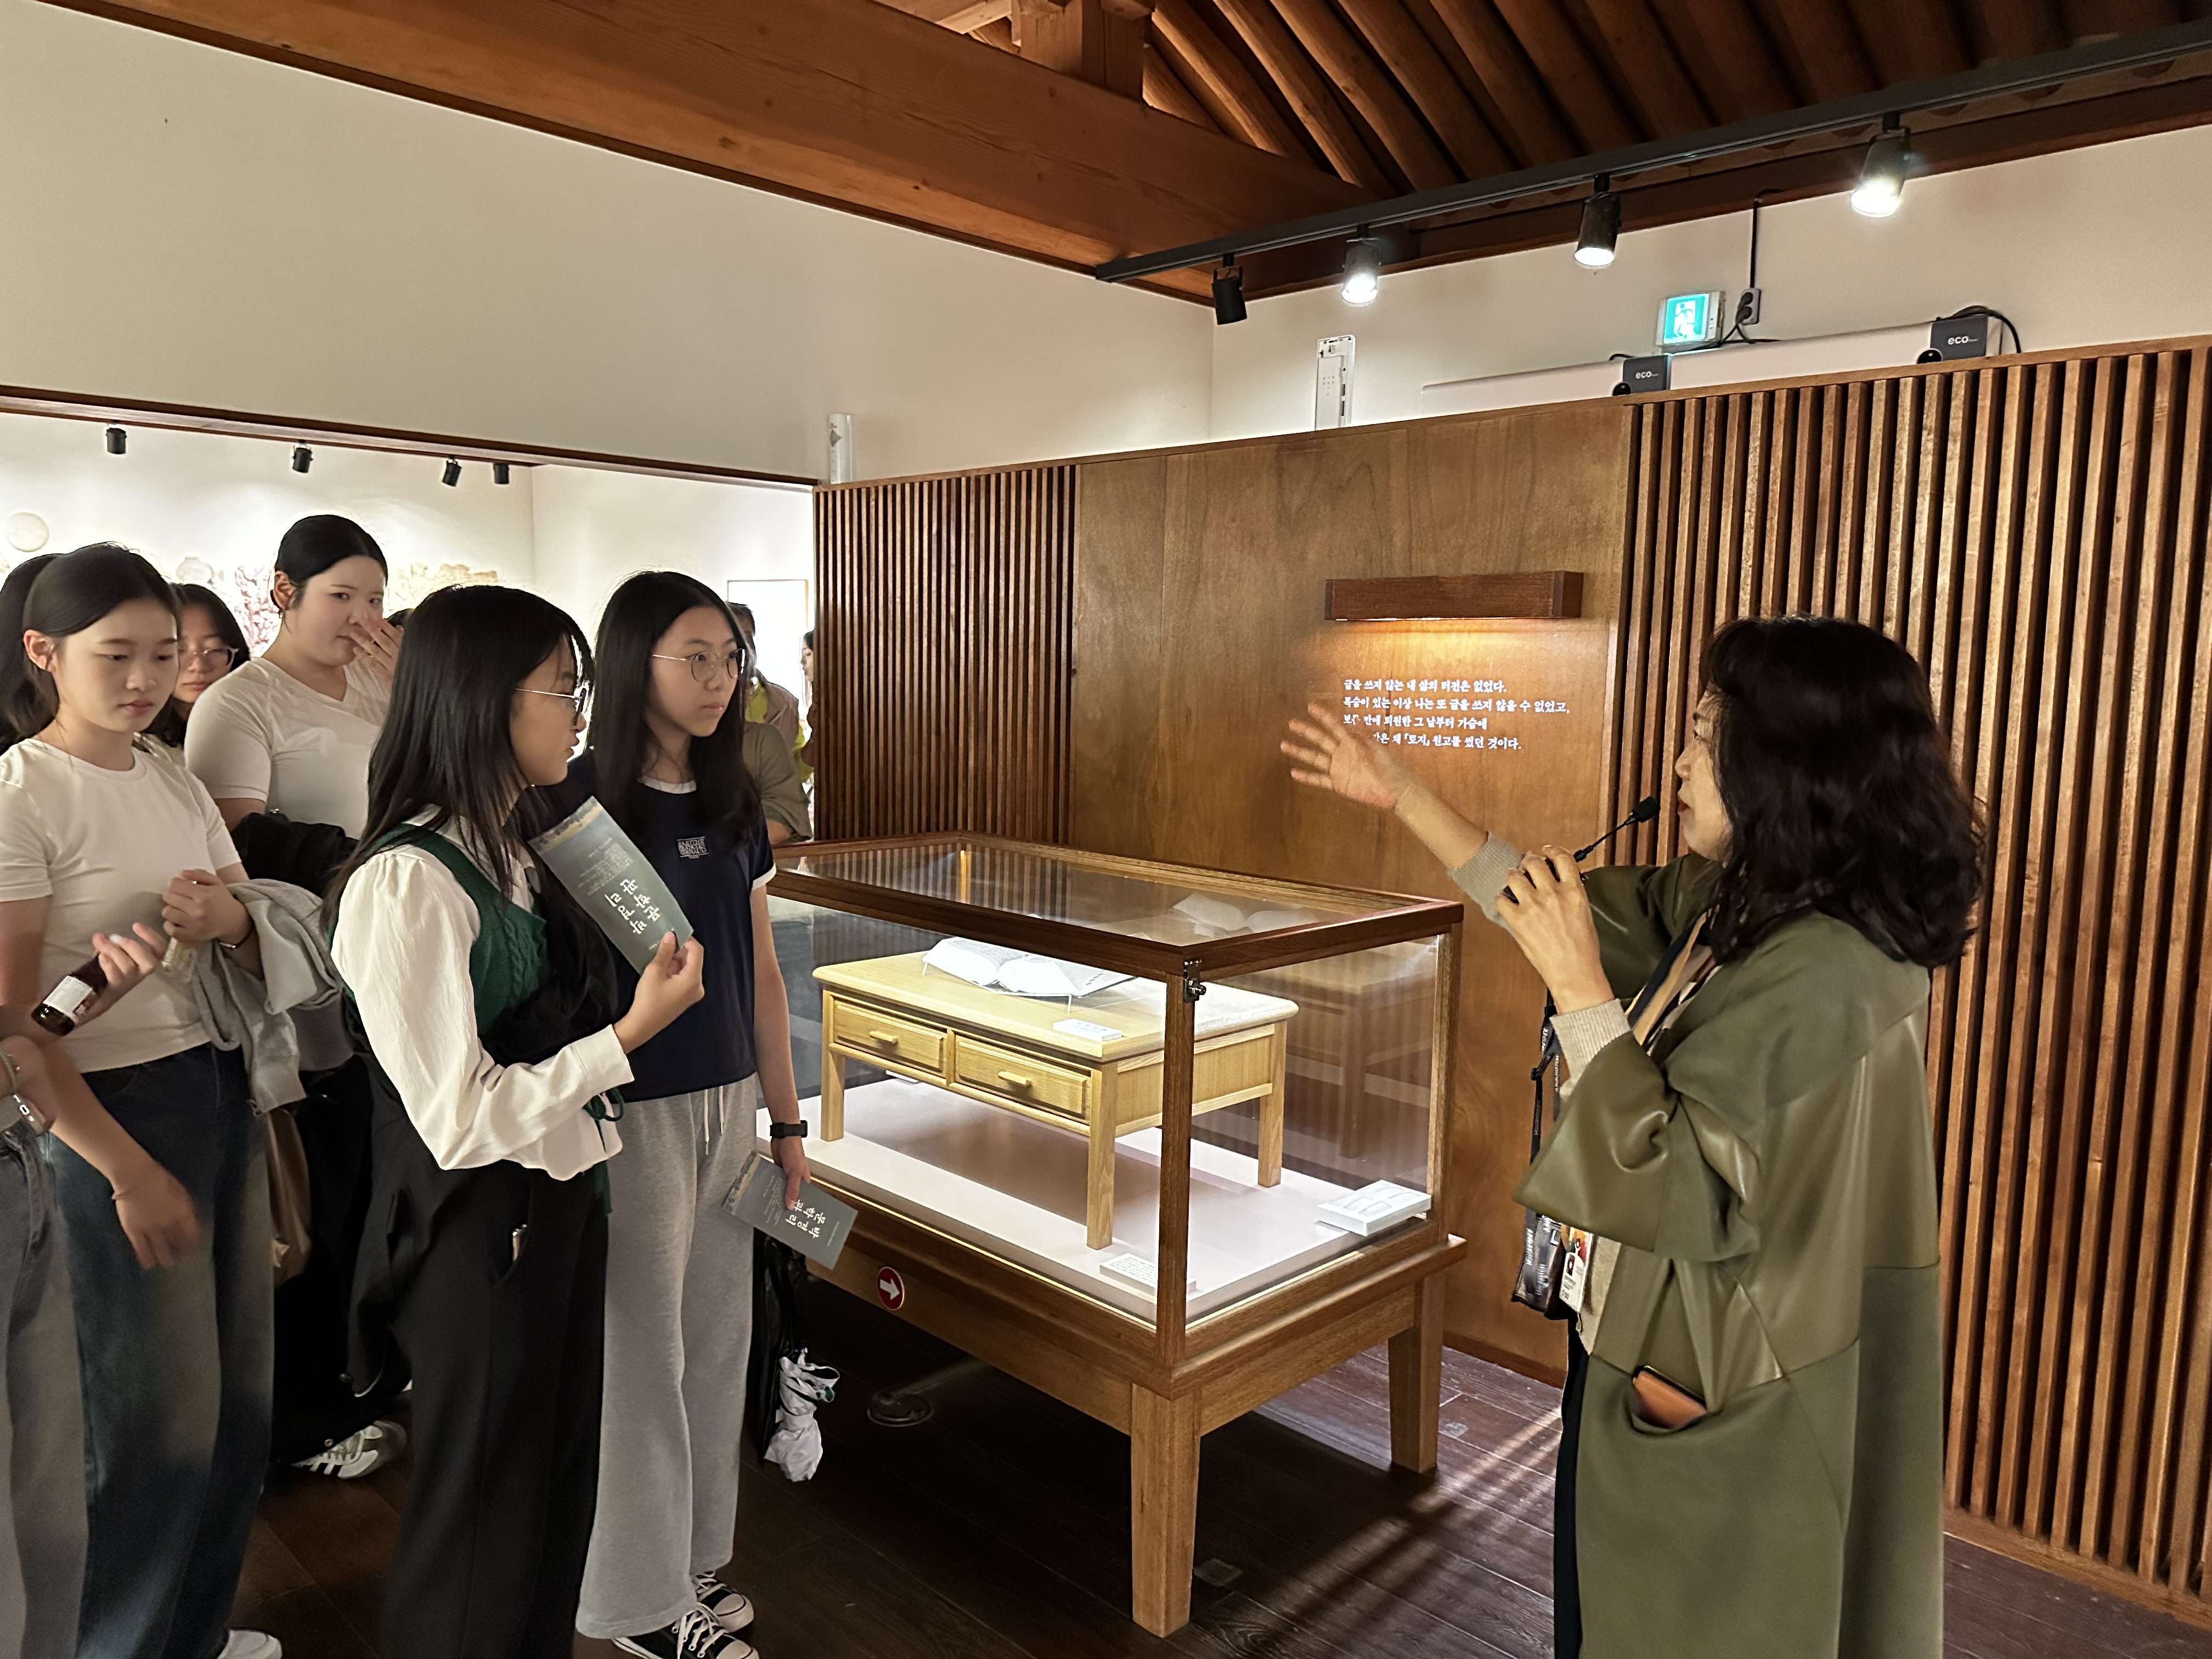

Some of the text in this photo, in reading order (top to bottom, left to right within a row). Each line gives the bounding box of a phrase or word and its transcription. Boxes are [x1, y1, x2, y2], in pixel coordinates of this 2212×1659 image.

[1948, 336, 1968, 345] eco
[1635, 371, 1652, 379] eco
[1344, 679, 1507, 693] 글을 쓰지 않는 내 삶의 터전은 없었다.
[1343, 696, 1570, 714] 목숨이 있는 이상 나는 또 글을 쓰지 않을 수 없었고,
[1363, 714, 1381, 726] 만에
[1383, 714, 1412, 727] 퇴원한
[1413, 717, 1424, 727] 그
[1426, 716, 1454, 729] 날부터
[1457, 717, 1487, 730] 가슴에
[1392, 733, 1401, 745] 채
[1432, 735, 1462, 747] 원고를
[1464, 736, 1484, 748] 썼던
[1487, 737, 1522, 750] 것이다.
[619, 878, 661, 922] 문학관
[604, 893, 647, 934] 박경리
[785, 1214, 821, 1238] 박경리
